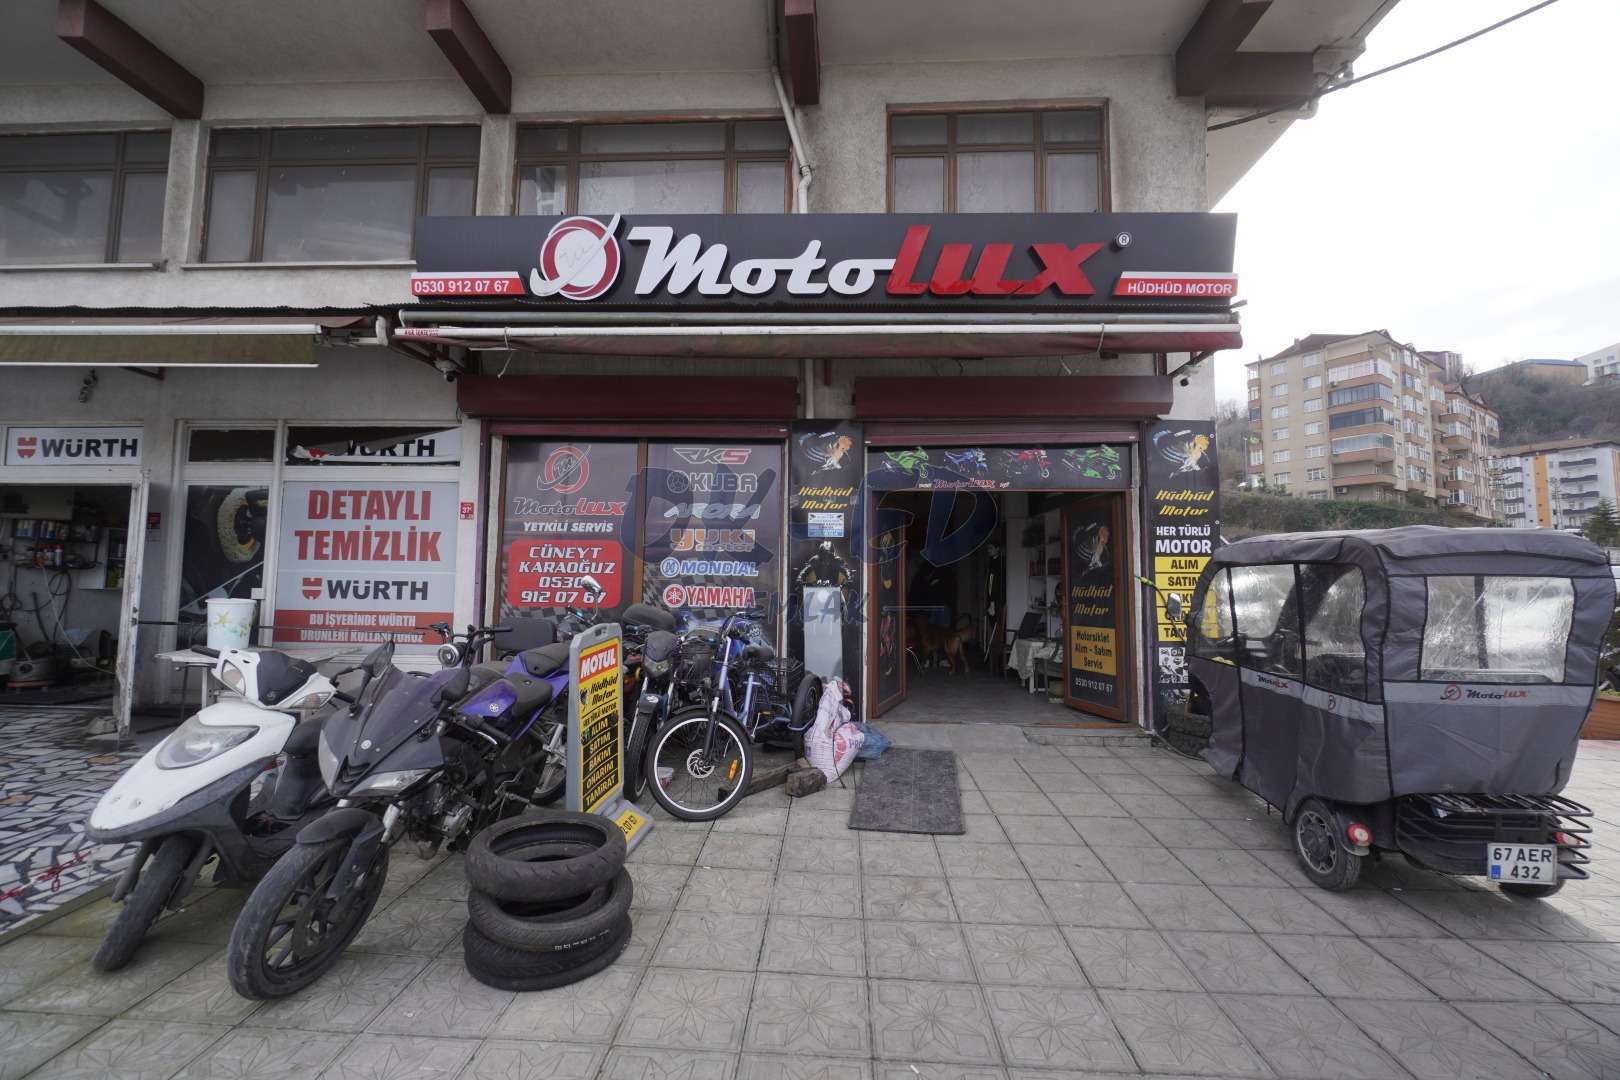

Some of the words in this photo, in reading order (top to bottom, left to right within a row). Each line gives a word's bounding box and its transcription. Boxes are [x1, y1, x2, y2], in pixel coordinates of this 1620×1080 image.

[414, 281, 445, 293] 0530
[448, 280, 471, 292] 912
[475, 280, 488, 292] 07
[494, 280, 510, 291] 67
[1127, 281, 1182, 293] HÜDHÜD
[1185, 283, 1233, 294] MOTOR
[41, 438, 138, 457] WÜRTH
[689, 472, 758, 493] KUBA
[308, 490, 431, 520] DETAYLI
[801, 500, 848, 511] Motor
[1159, 505, 1208, 517] Motor
[523, 520, 568, 532] YETKİLİ
[571, 520, 614, 532] SERVİS
[1156, 527, 1176, 536] HER
[1179, 524, 1211, 536] TÜRLÜ
[295, 525, 442, 561] TEMİZLİK
[1155, 540, 1212, 553] MOTOR
[529, 544, 602, 558] CÜNEYT
[519, 560, 616, 574] KARAOĞUZ
[680, 560, 759, 577] MONDIAL
[1170, 560, 1199, 569] ALIM
[539, 576, 583, 588] 0530
[327, 580, 429, 600] WÜRTH
[685, 586, 756, 608] YAMAHA
[521, 591, 551, 603] 912
[555, 592, 579, 603] 07
[583, 591, 607, 604] 67
[379, 613, 416, 627] WÜRTH
[580, 648, 616, 679] MOTUL
[1494, 847, 1512, 861] 67
[1516, 848, 1552, 863] AER
[1511, 865, 1541, 879] 432
